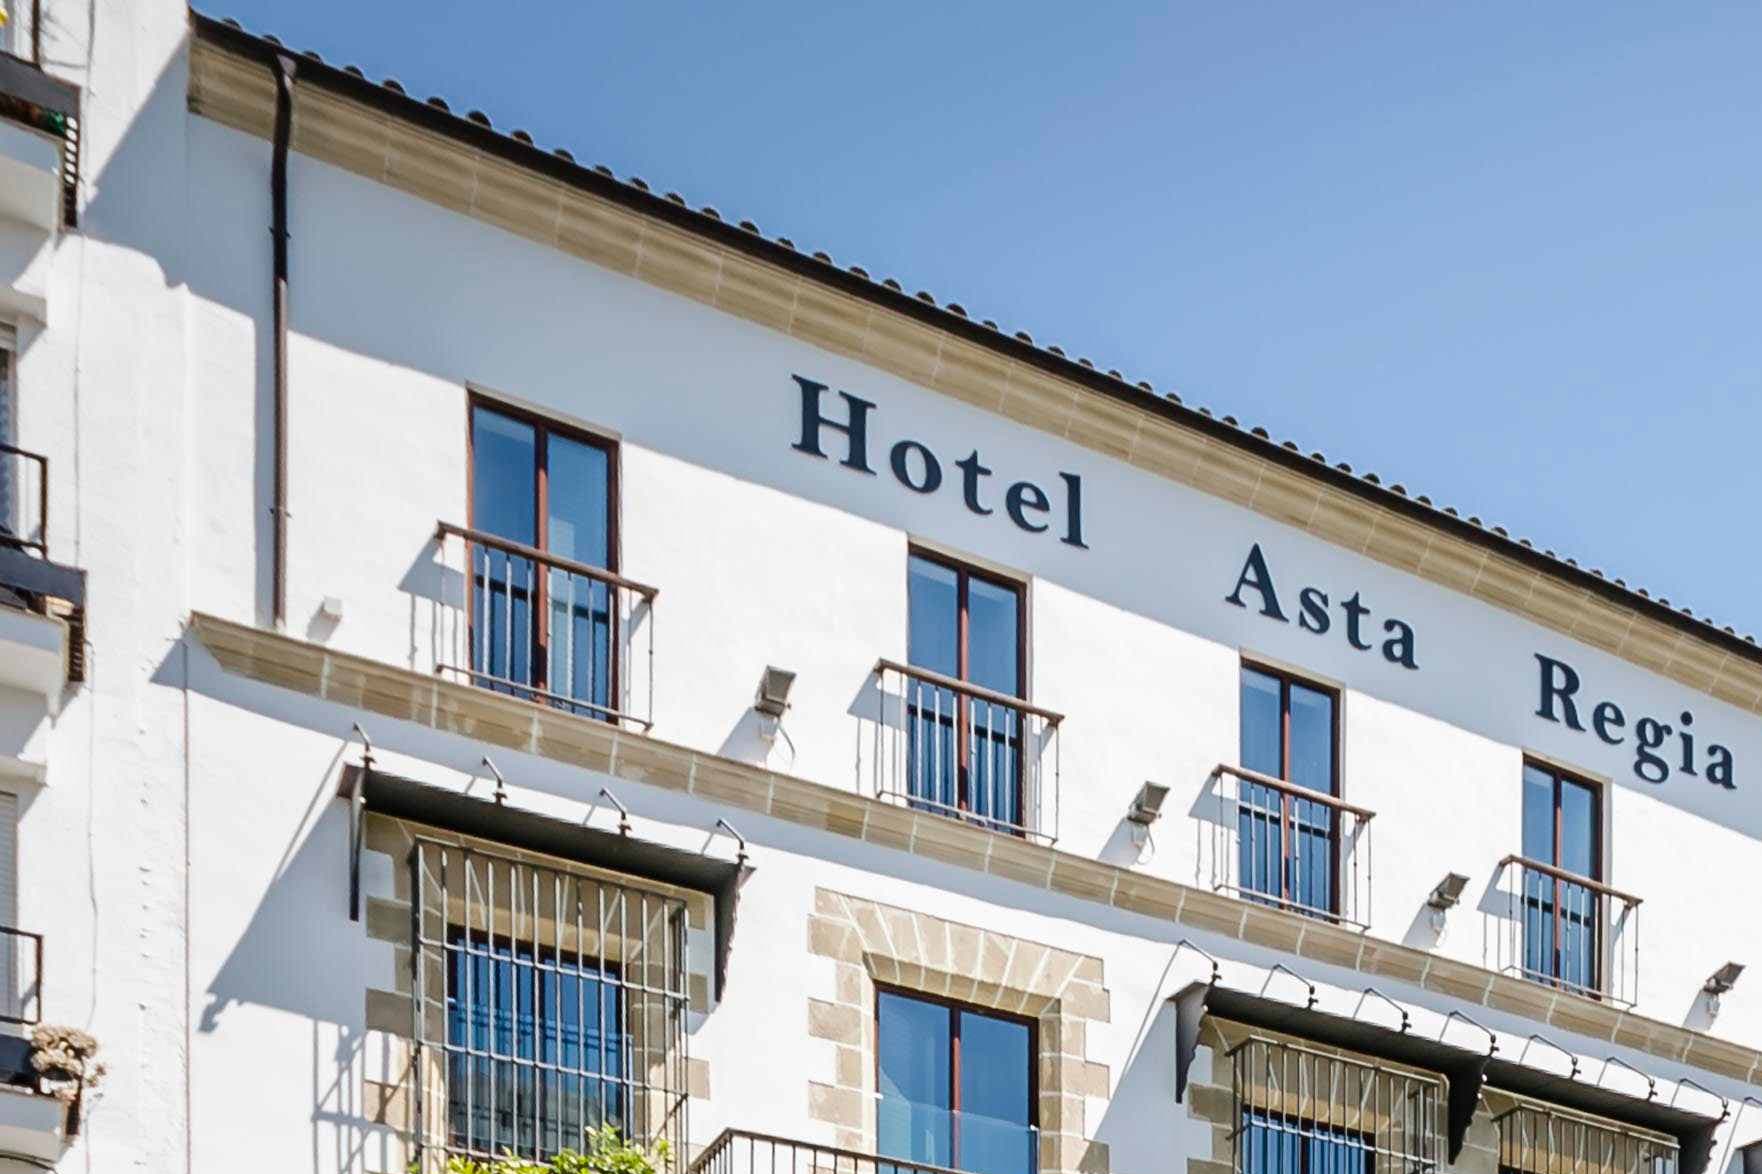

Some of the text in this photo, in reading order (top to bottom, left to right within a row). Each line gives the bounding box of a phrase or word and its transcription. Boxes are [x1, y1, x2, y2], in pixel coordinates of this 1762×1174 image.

[791, 373, 1090, 550] Hotel
[1225, 542, 1420, 670] Asta
[1533, 652, 1738, 790] Regia
